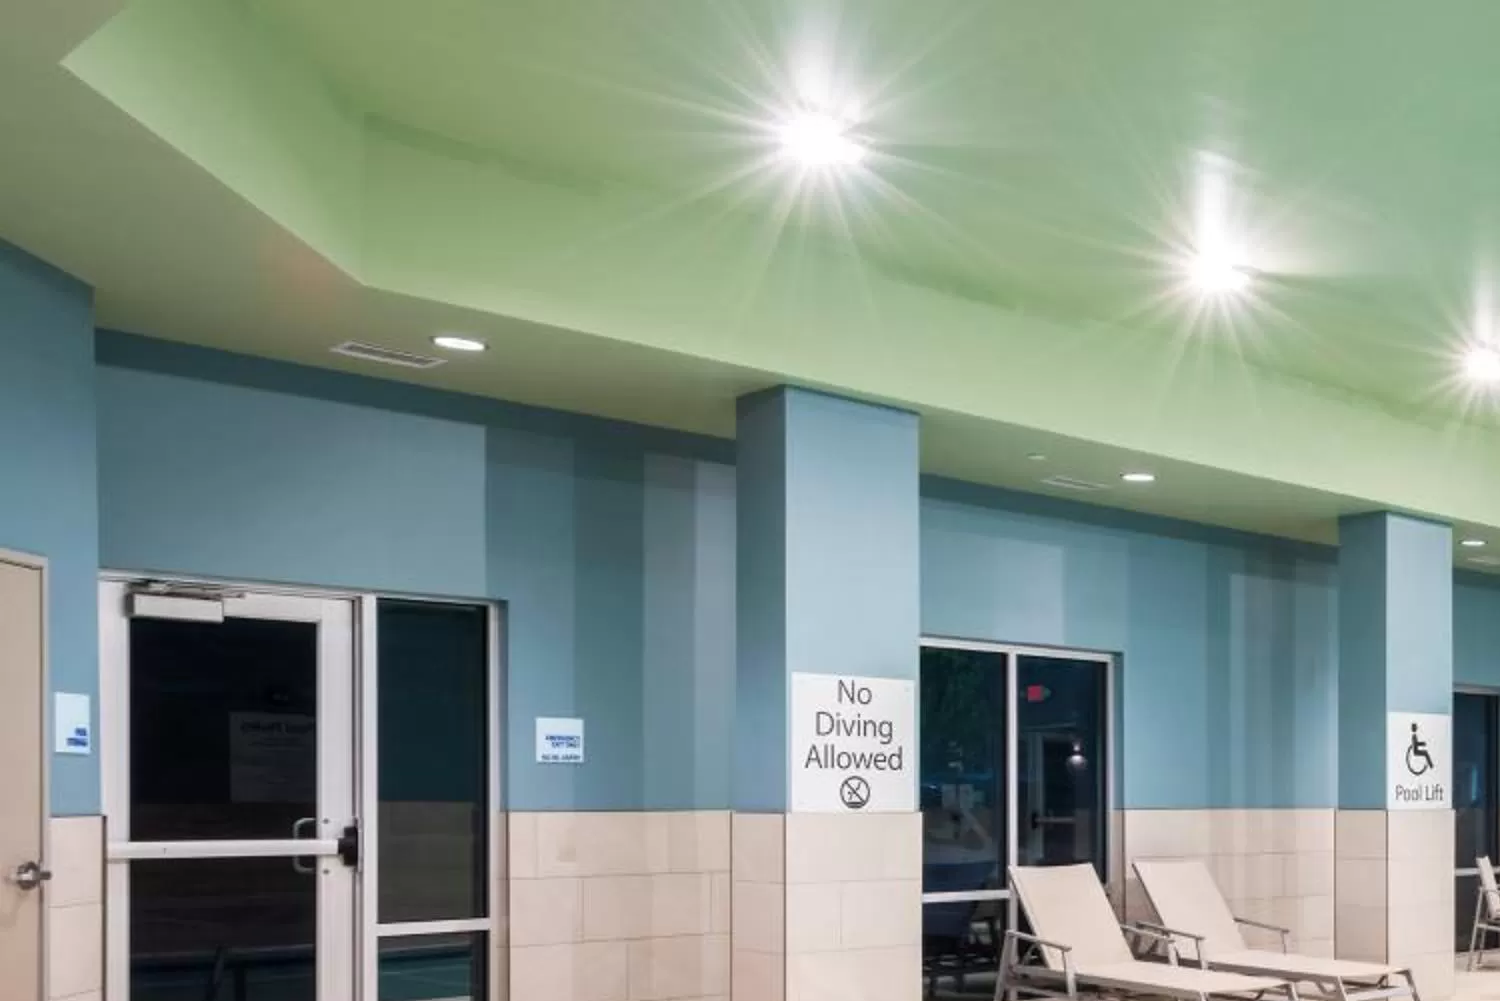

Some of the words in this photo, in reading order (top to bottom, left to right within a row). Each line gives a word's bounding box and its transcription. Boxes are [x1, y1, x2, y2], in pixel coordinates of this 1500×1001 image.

[837, 679, 873, 705] No
[815, 711, 893, 745] Diving
[804, 743, 903, 770] Allowed
[1395, 784, 1422, 801] Pool
[1425, 783, 1443, 801] Lift
